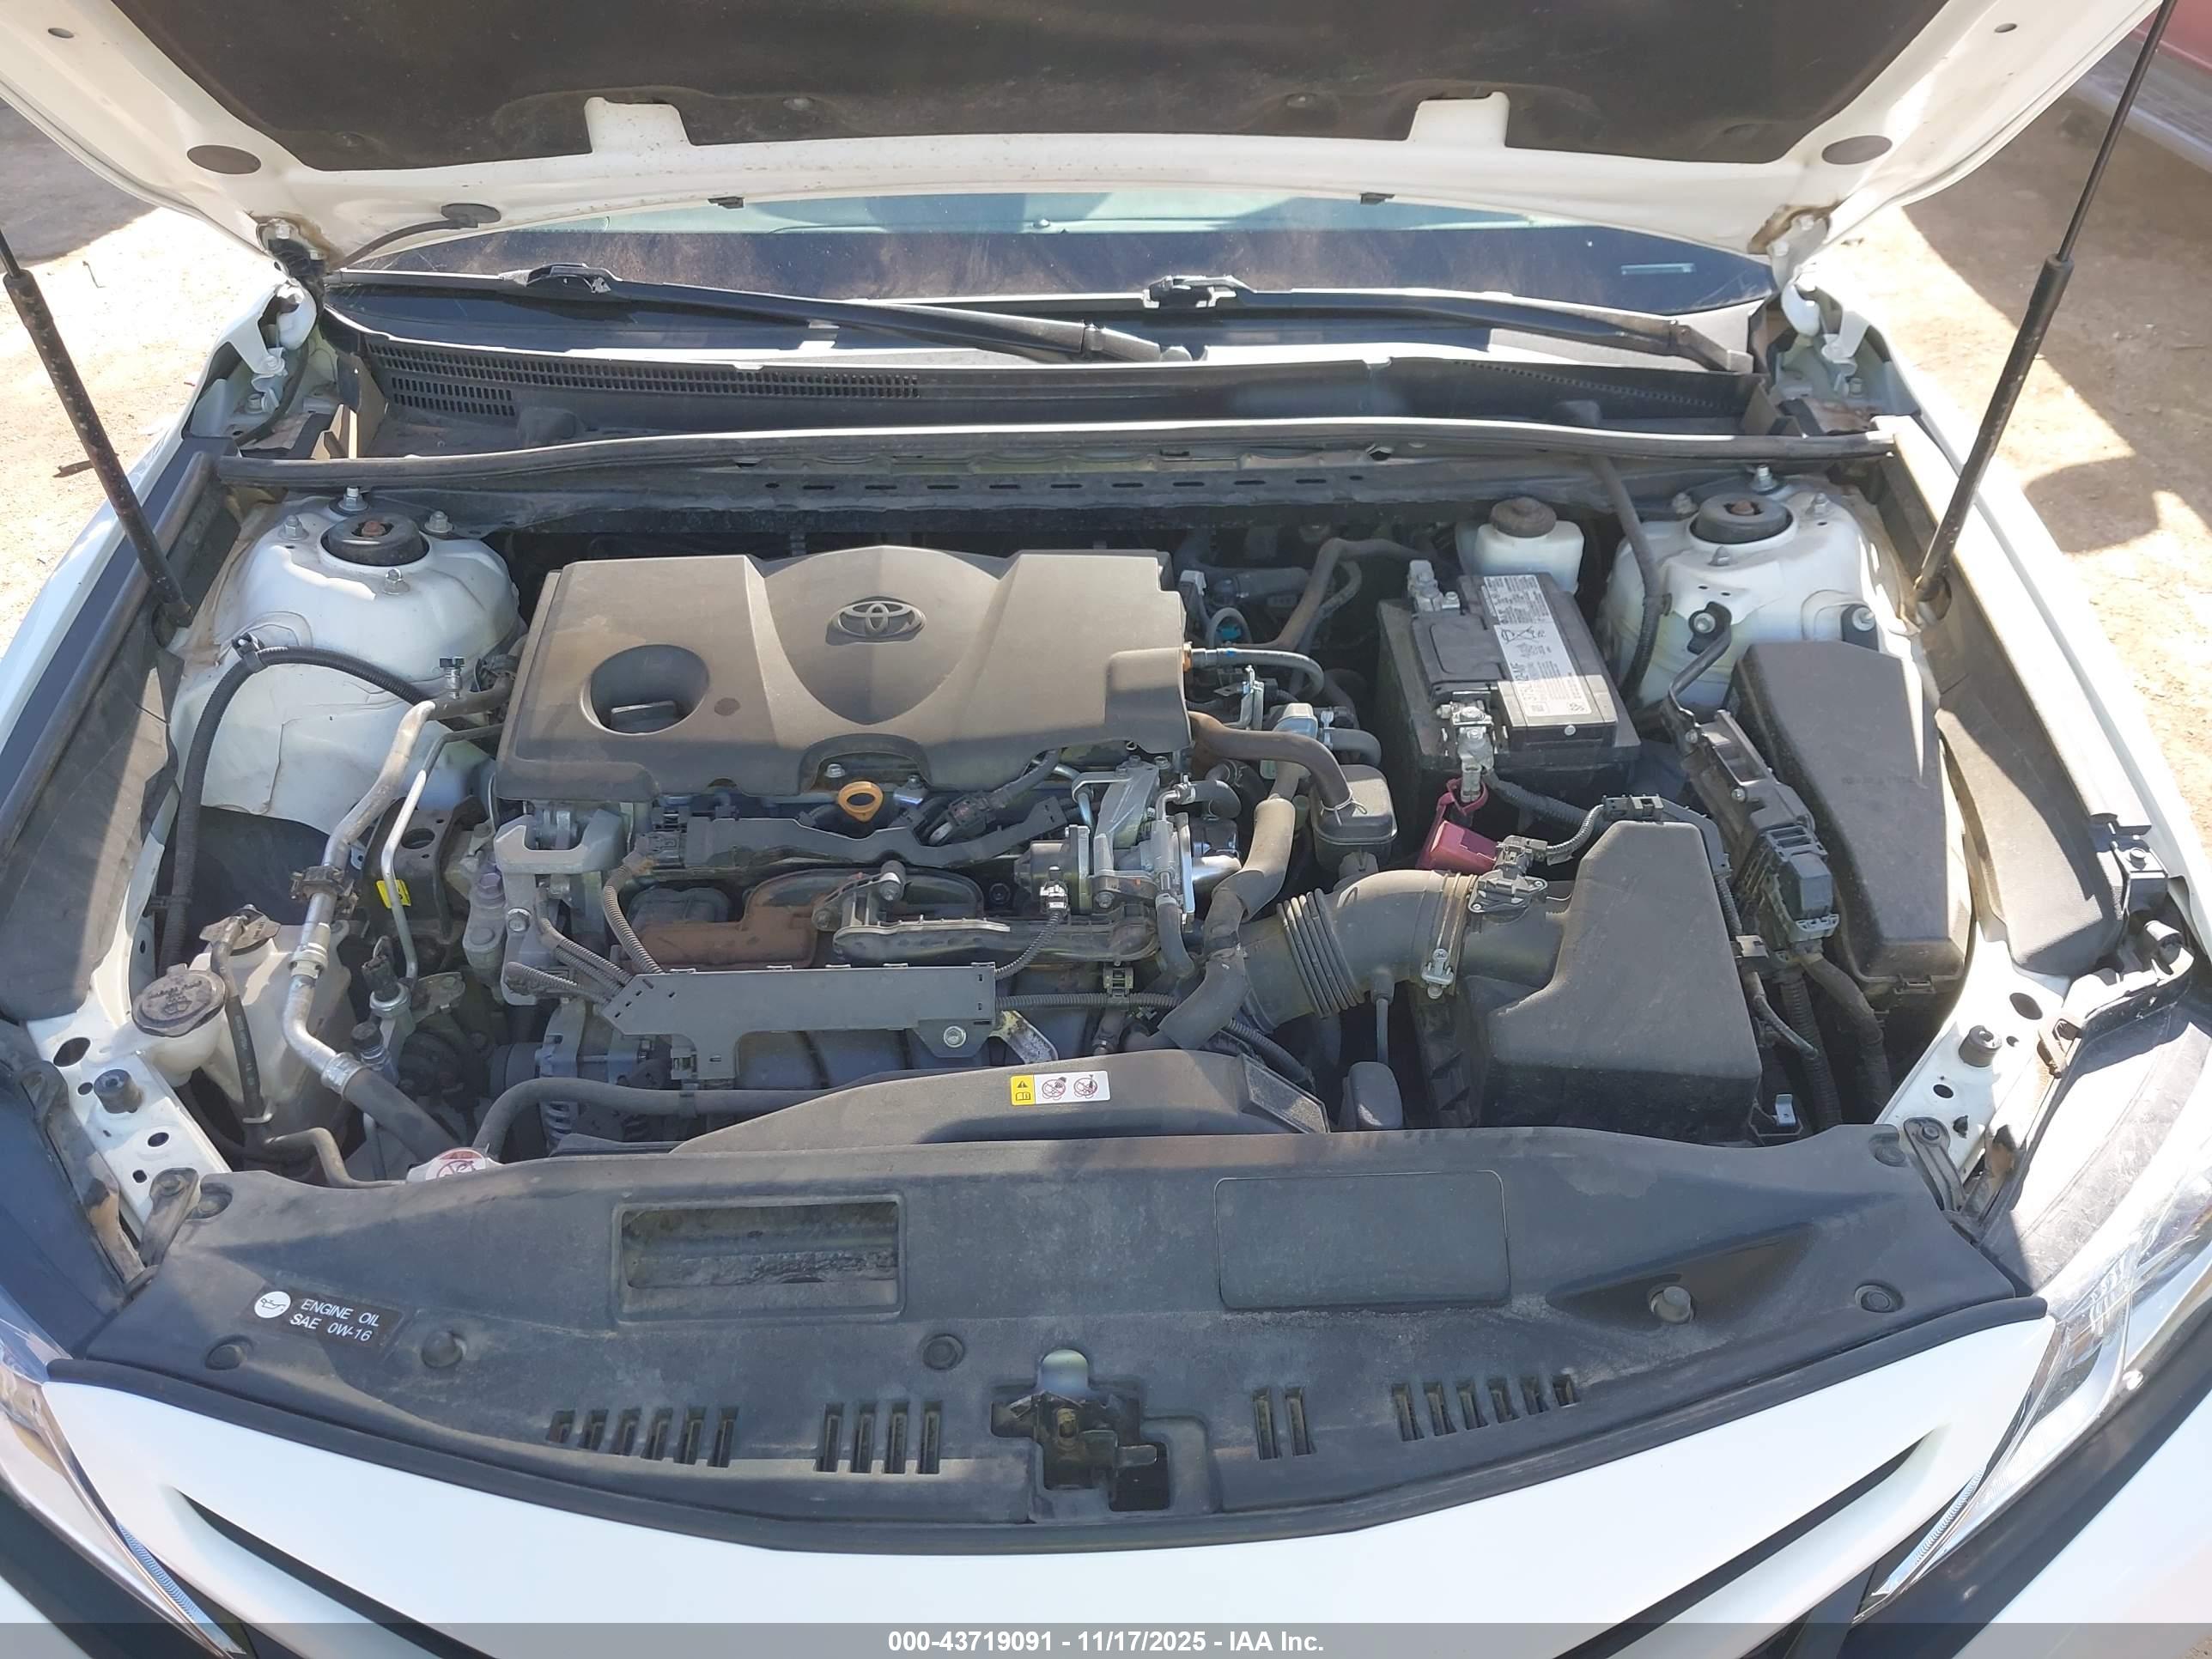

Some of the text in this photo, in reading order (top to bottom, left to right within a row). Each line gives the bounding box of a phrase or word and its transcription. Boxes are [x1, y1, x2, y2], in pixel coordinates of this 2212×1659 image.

[301, 1298, 380, 1327] ENGINE OIL
[289, 1313, 373, 1341] SAE 0W-16
